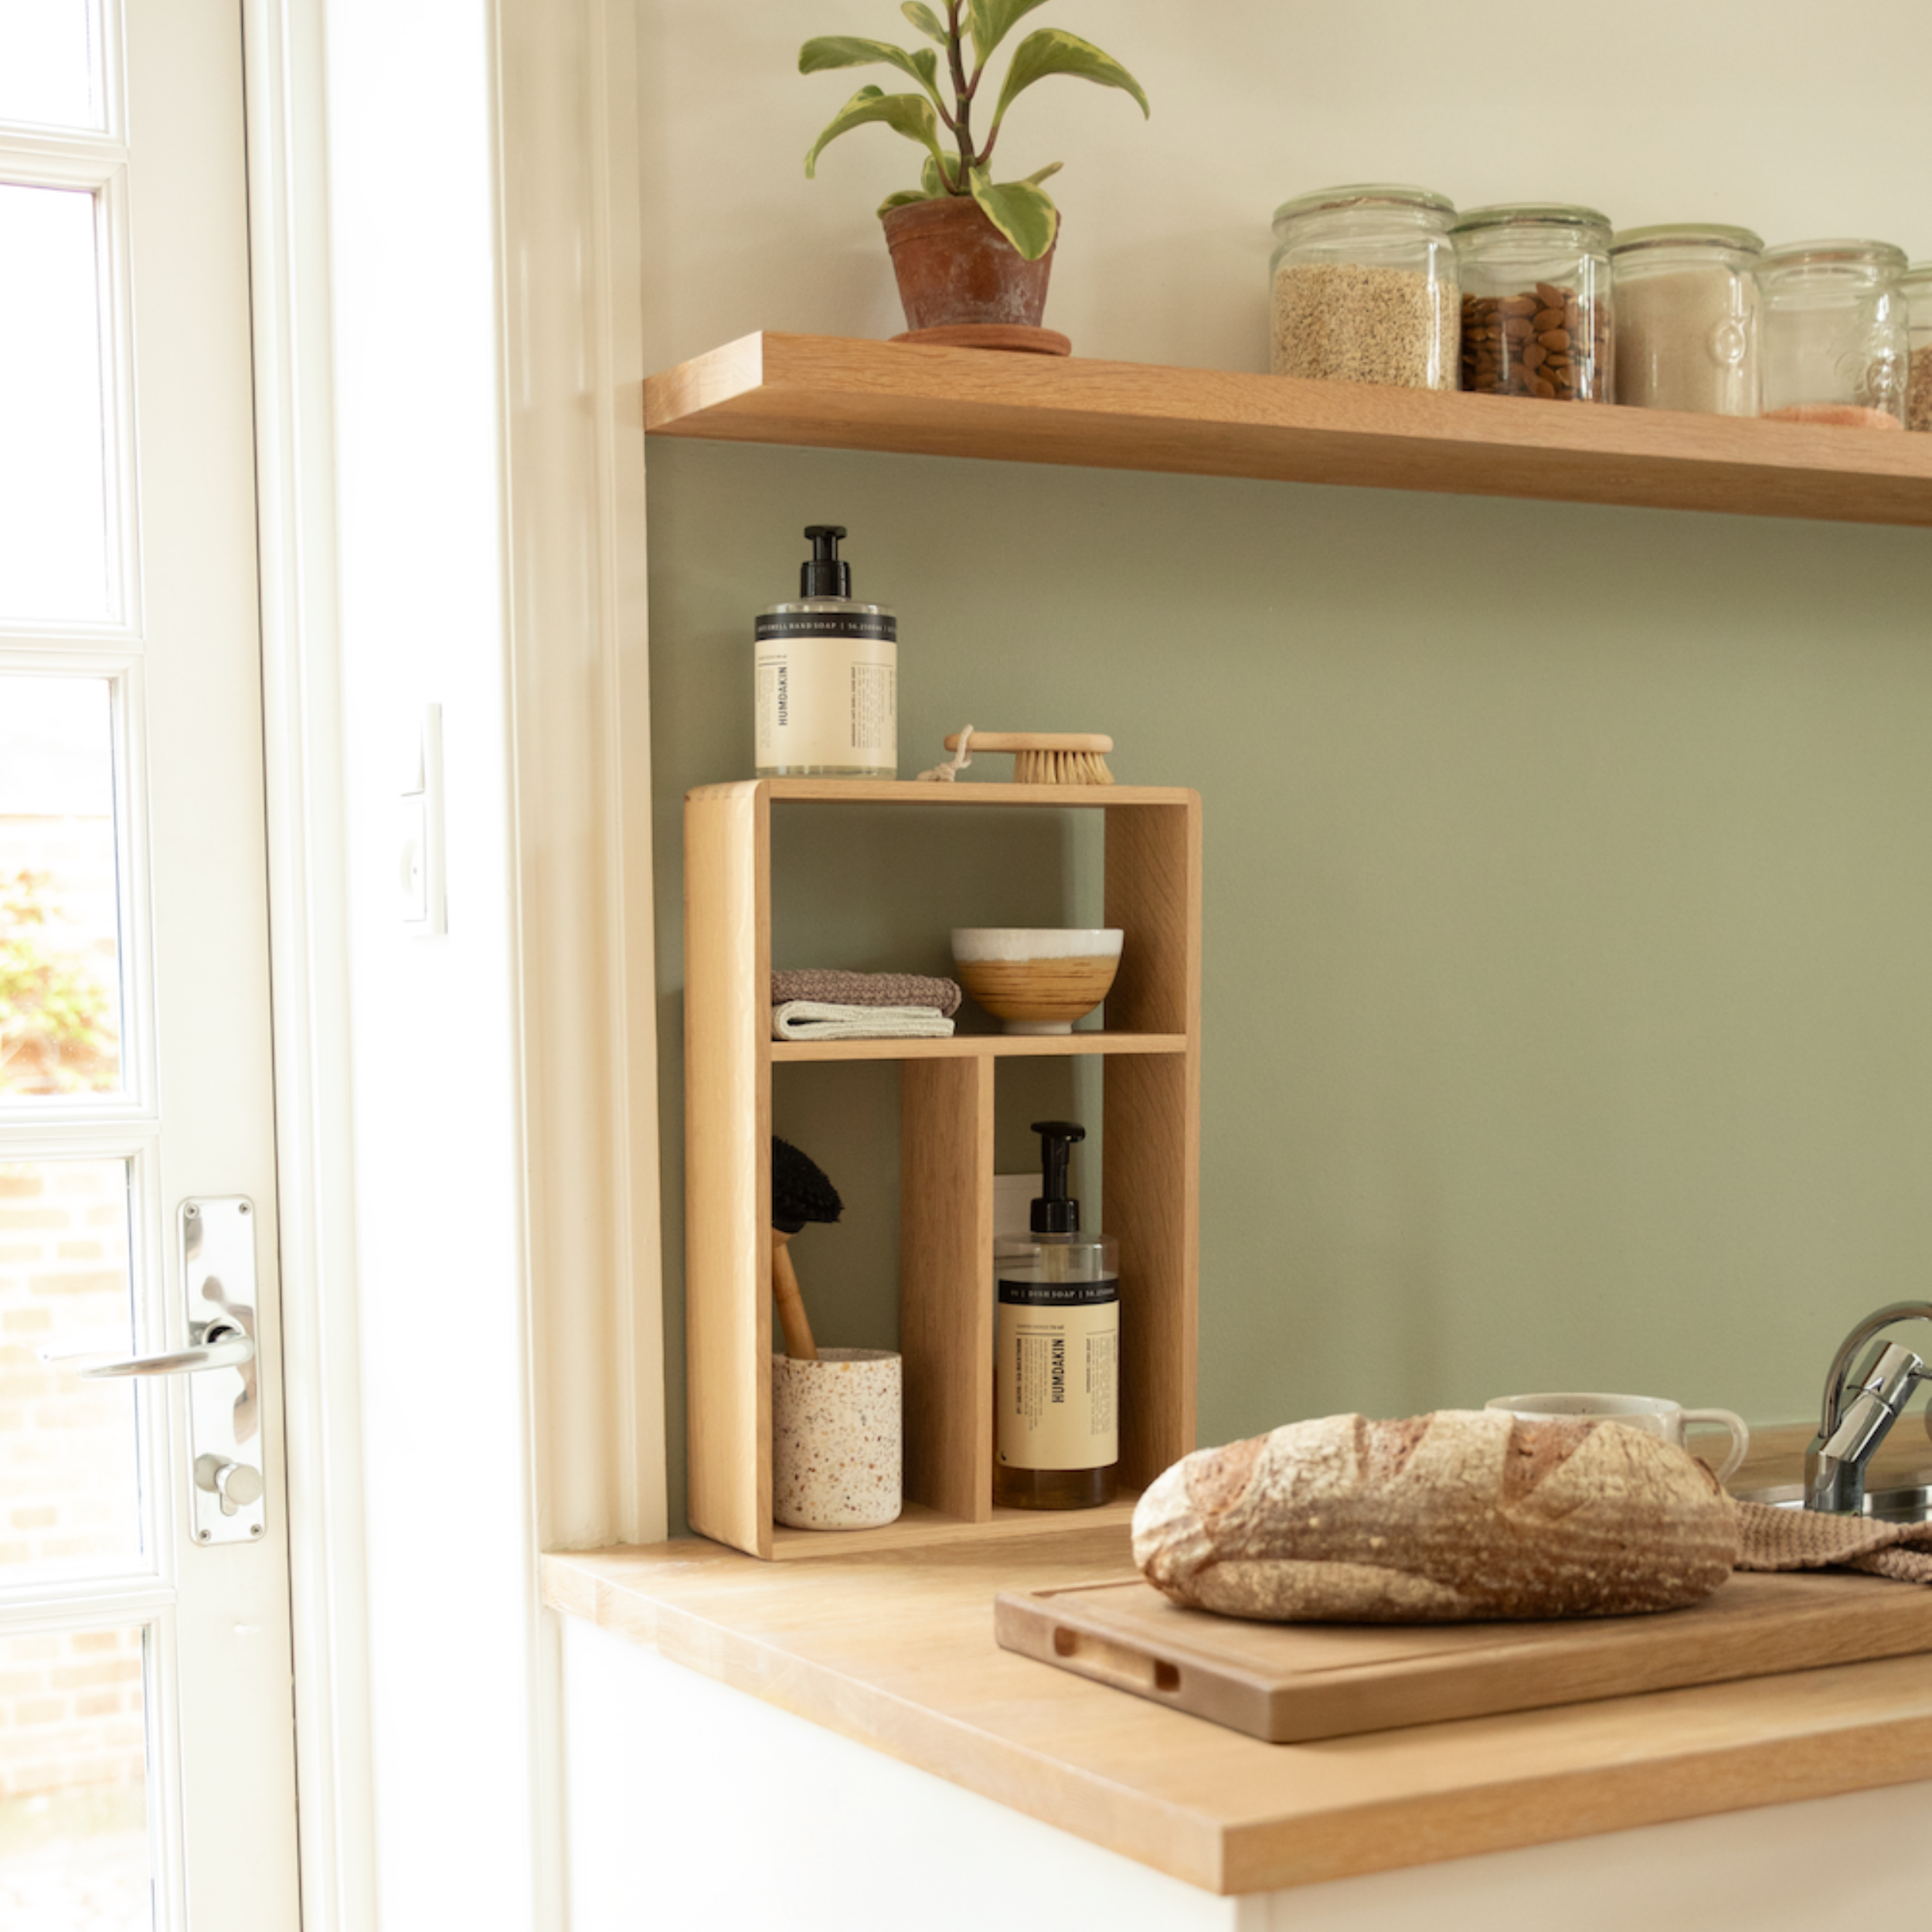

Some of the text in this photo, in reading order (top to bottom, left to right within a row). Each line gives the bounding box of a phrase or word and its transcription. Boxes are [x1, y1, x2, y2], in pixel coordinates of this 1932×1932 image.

[777, 666, 787, 726] HUMDAKIN
[1028, 1289, 1050, 1298] DISH
[1052, 1289, 1076, 1298] SOAP
[1051, 1338, 1064, 1403] HUMDAKIN
